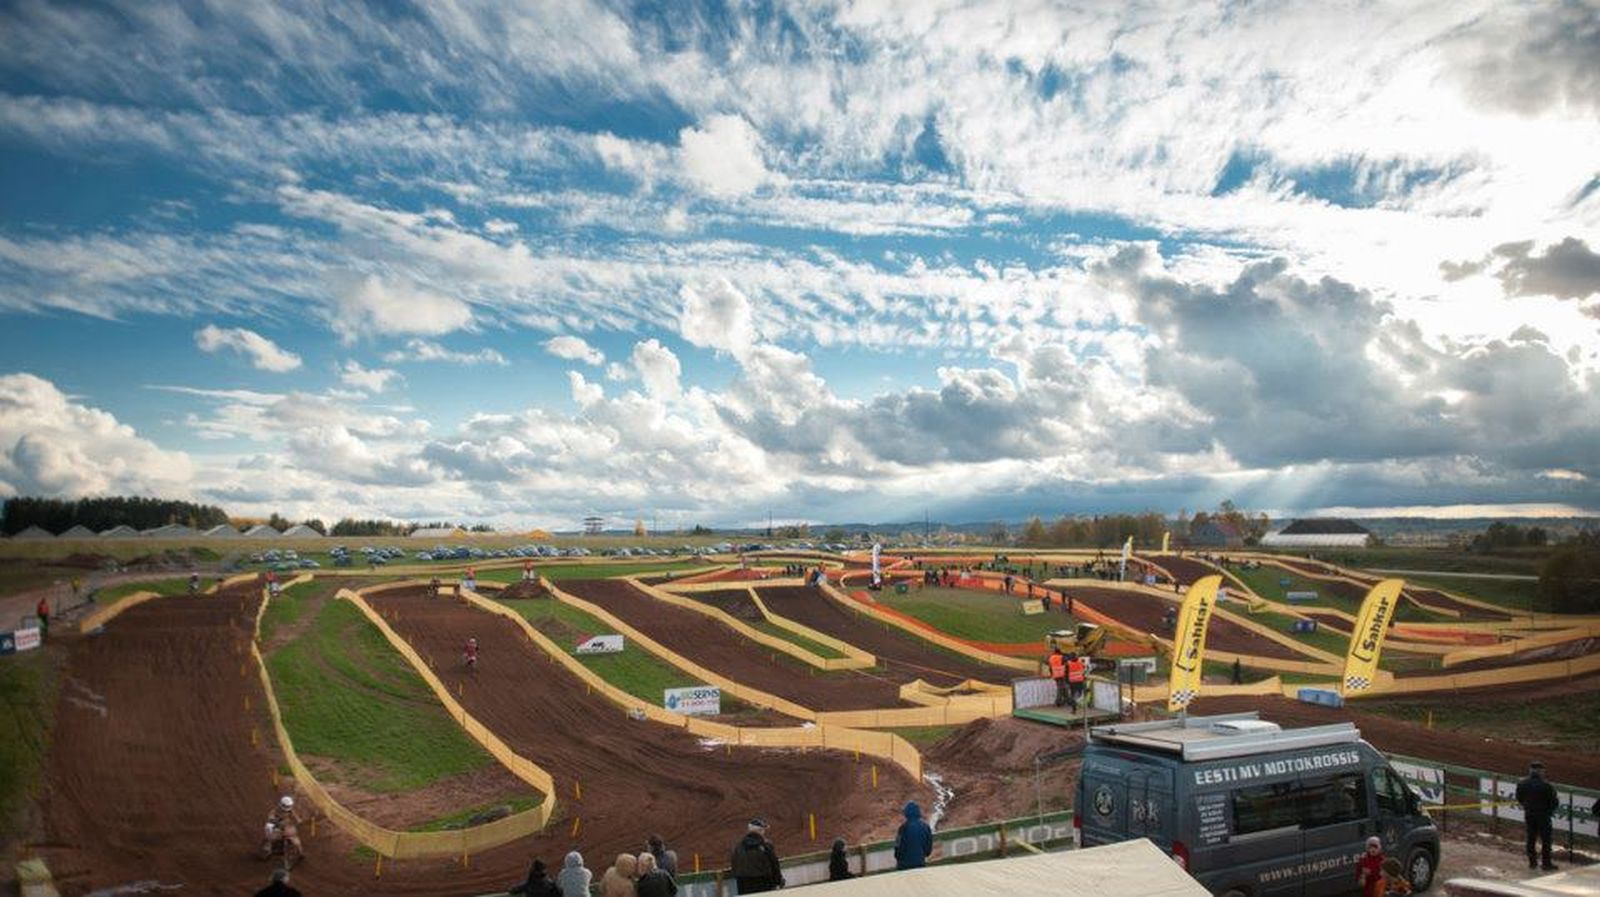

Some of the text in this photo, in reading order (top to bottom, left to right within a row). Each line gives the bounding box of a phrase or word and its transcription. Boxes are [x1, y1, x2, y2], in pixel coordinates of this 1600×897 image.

[1189, 598, 1208, 660] Sahkar
[1362, 597, 1389, 652] Sahkar
[1194, 750, 1361, 786] EESTI MV MOTOKROSSIS
